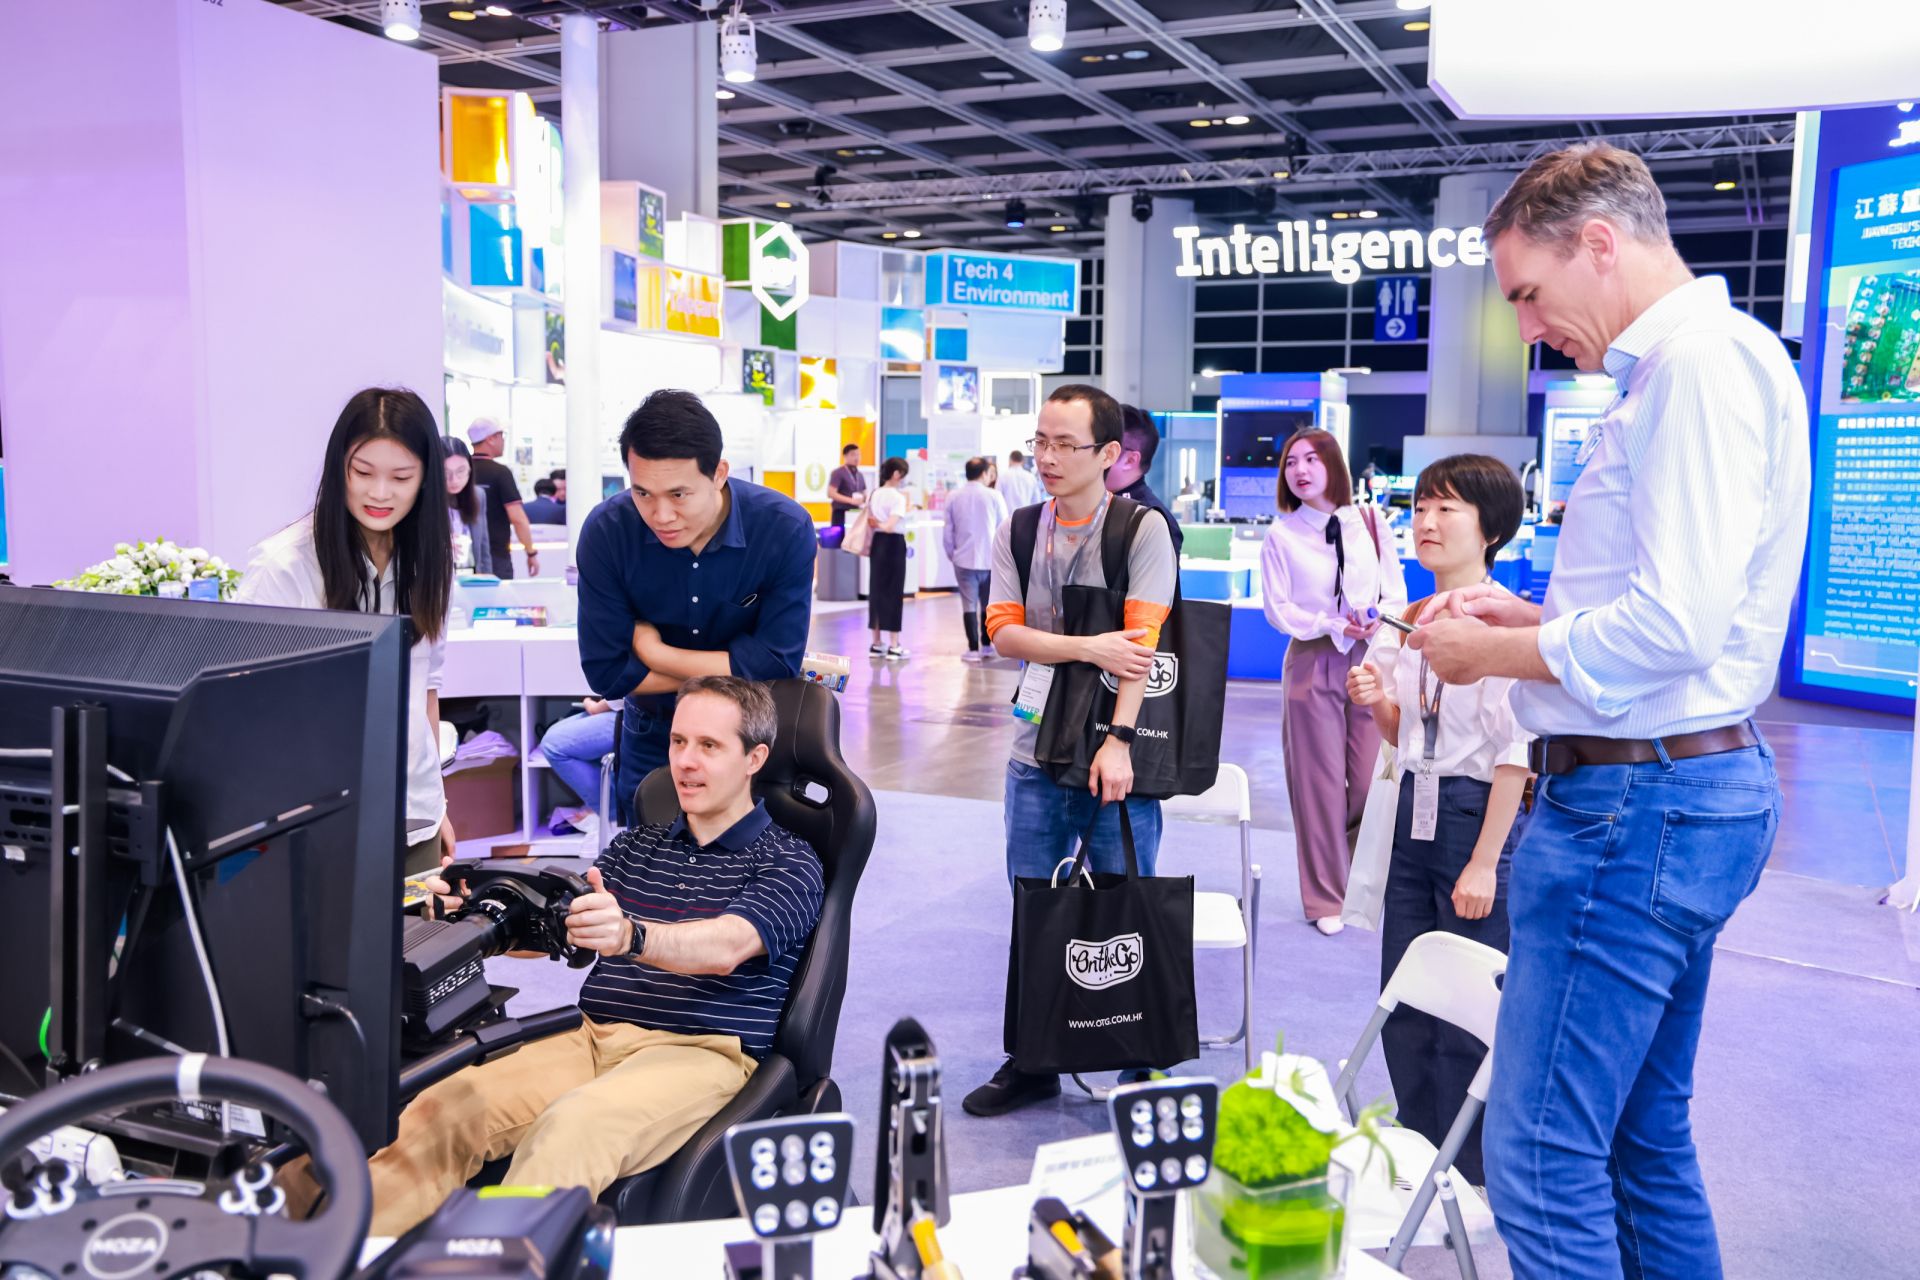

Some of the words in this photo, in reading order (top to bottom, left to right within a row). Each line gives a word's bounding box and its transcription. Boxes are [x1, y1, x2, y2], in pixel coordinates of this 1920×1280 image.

[1173, 219, 1486, 284] Intelligence
[953, 258, 998, 280] Tech
[1002, 262, 1014, 281] 4
[953, 281, 1069, 308] Environment
[429, 961, 481, 1004] MOZA
[1068, 1011, 1143, 1029] WWW.OTG.COM.HK
[91, 1236, 156, 1256] MOZA
[446, 1238, 504, 1257] MOZA
